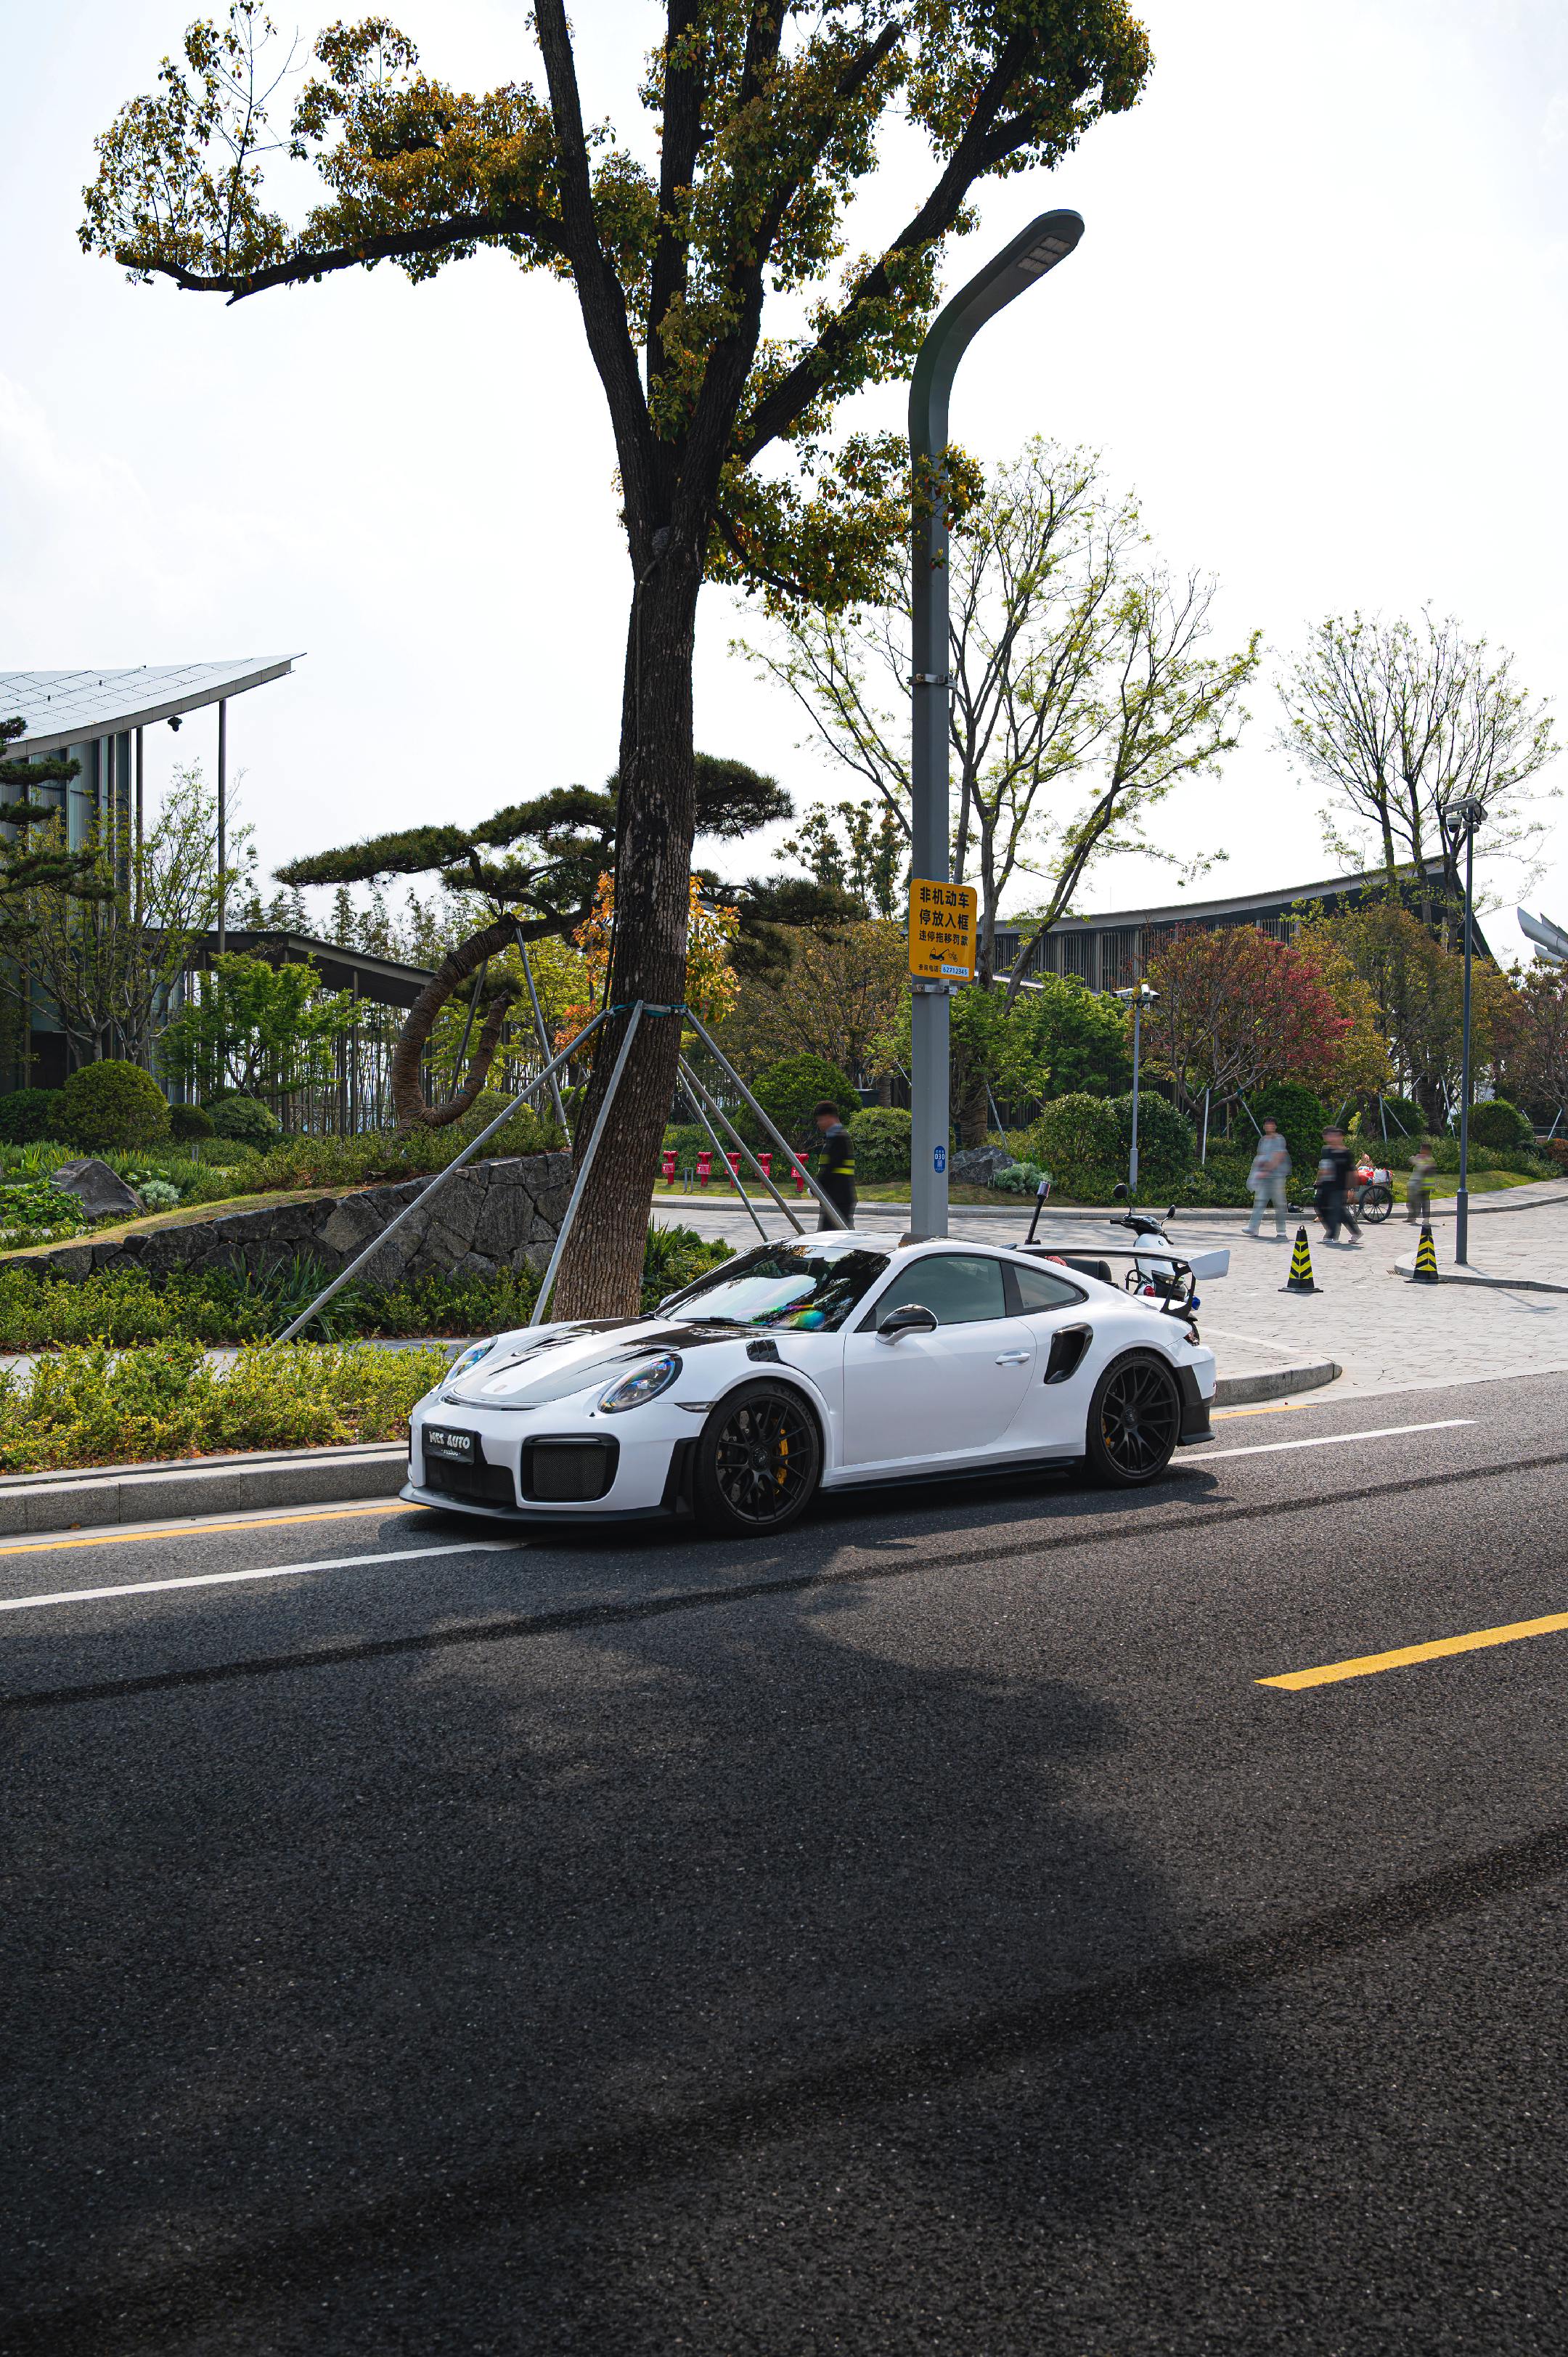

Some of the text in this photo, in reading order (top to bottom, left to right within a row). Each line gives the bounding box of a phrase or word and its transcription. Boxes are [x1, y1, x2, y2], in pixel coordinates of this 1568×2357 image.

[920, 887, 970, 908] 非机动车
[919, 908, 969, 930] 停放入框
[919, 930, 968, 946] 违停拖移罚款
[942, 966, 968, 975] 62712345
[446, 1434, 470, 1449] AUTO
